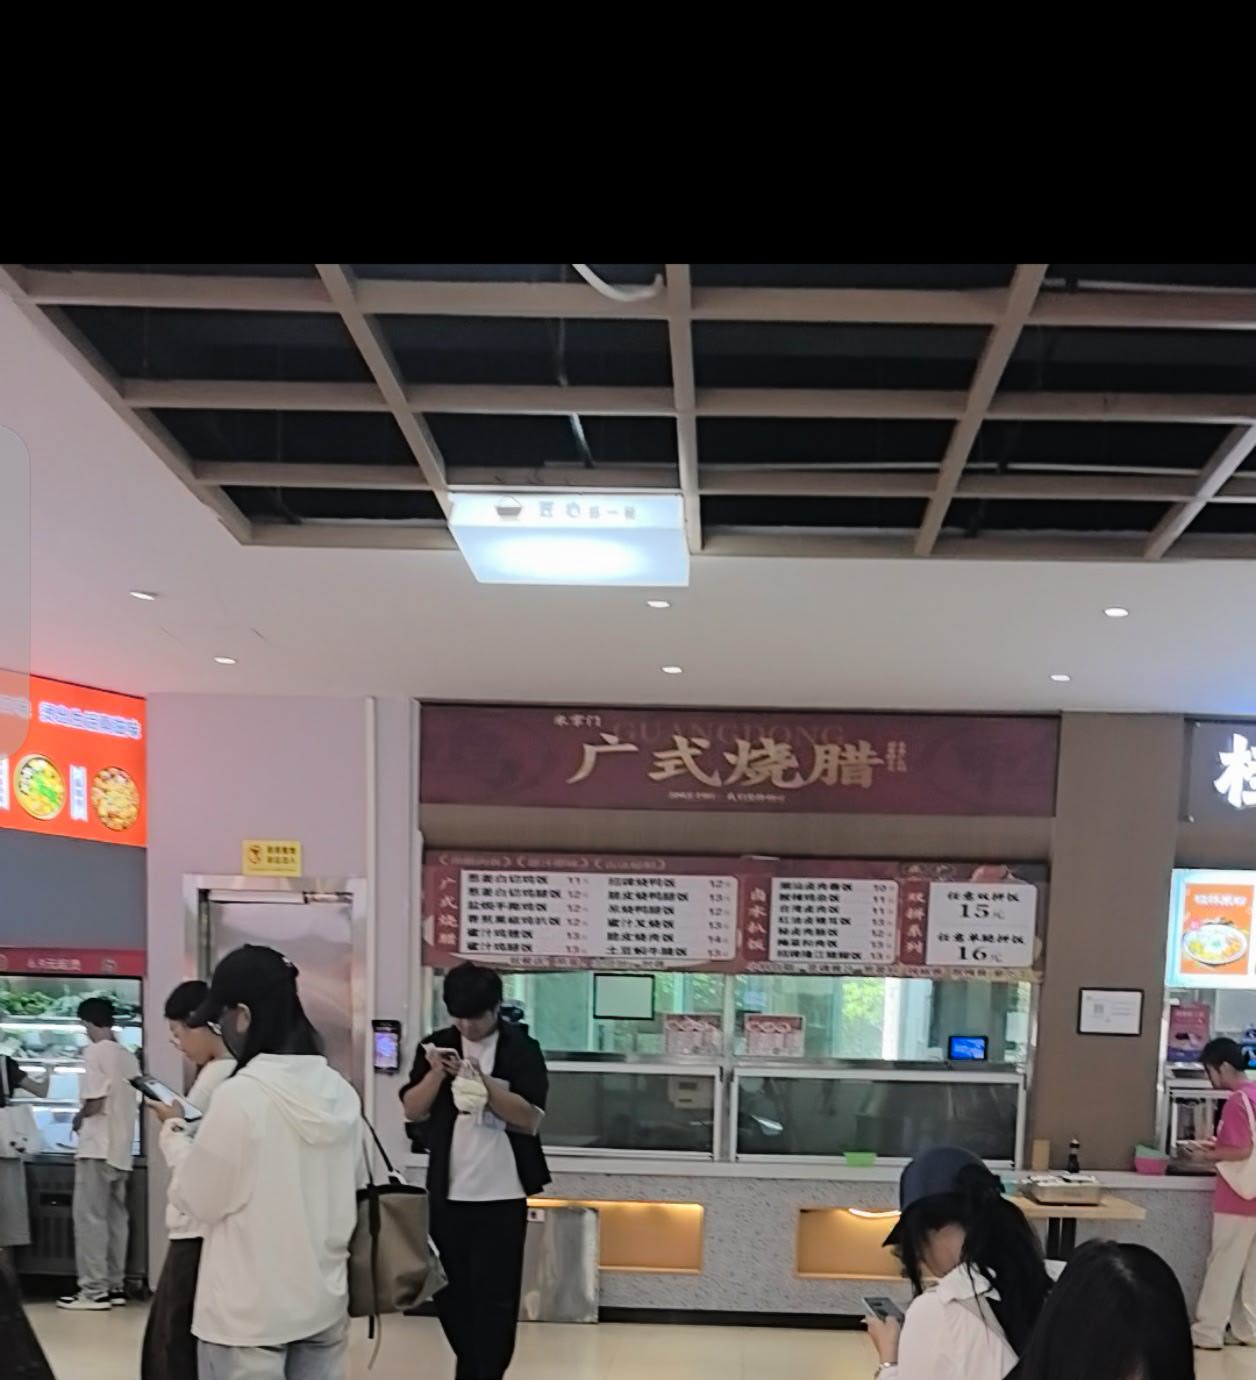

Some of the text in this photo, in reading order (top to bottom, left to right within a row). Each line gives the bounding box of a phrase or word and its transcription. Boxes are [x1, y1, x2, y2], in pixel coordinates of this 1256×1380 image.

[566, 733, 885, 790] 广式烧腊
[438, 876, 458, 945] 广式烧腊
[946, 890, 1020, 902] 任意双拼饭
